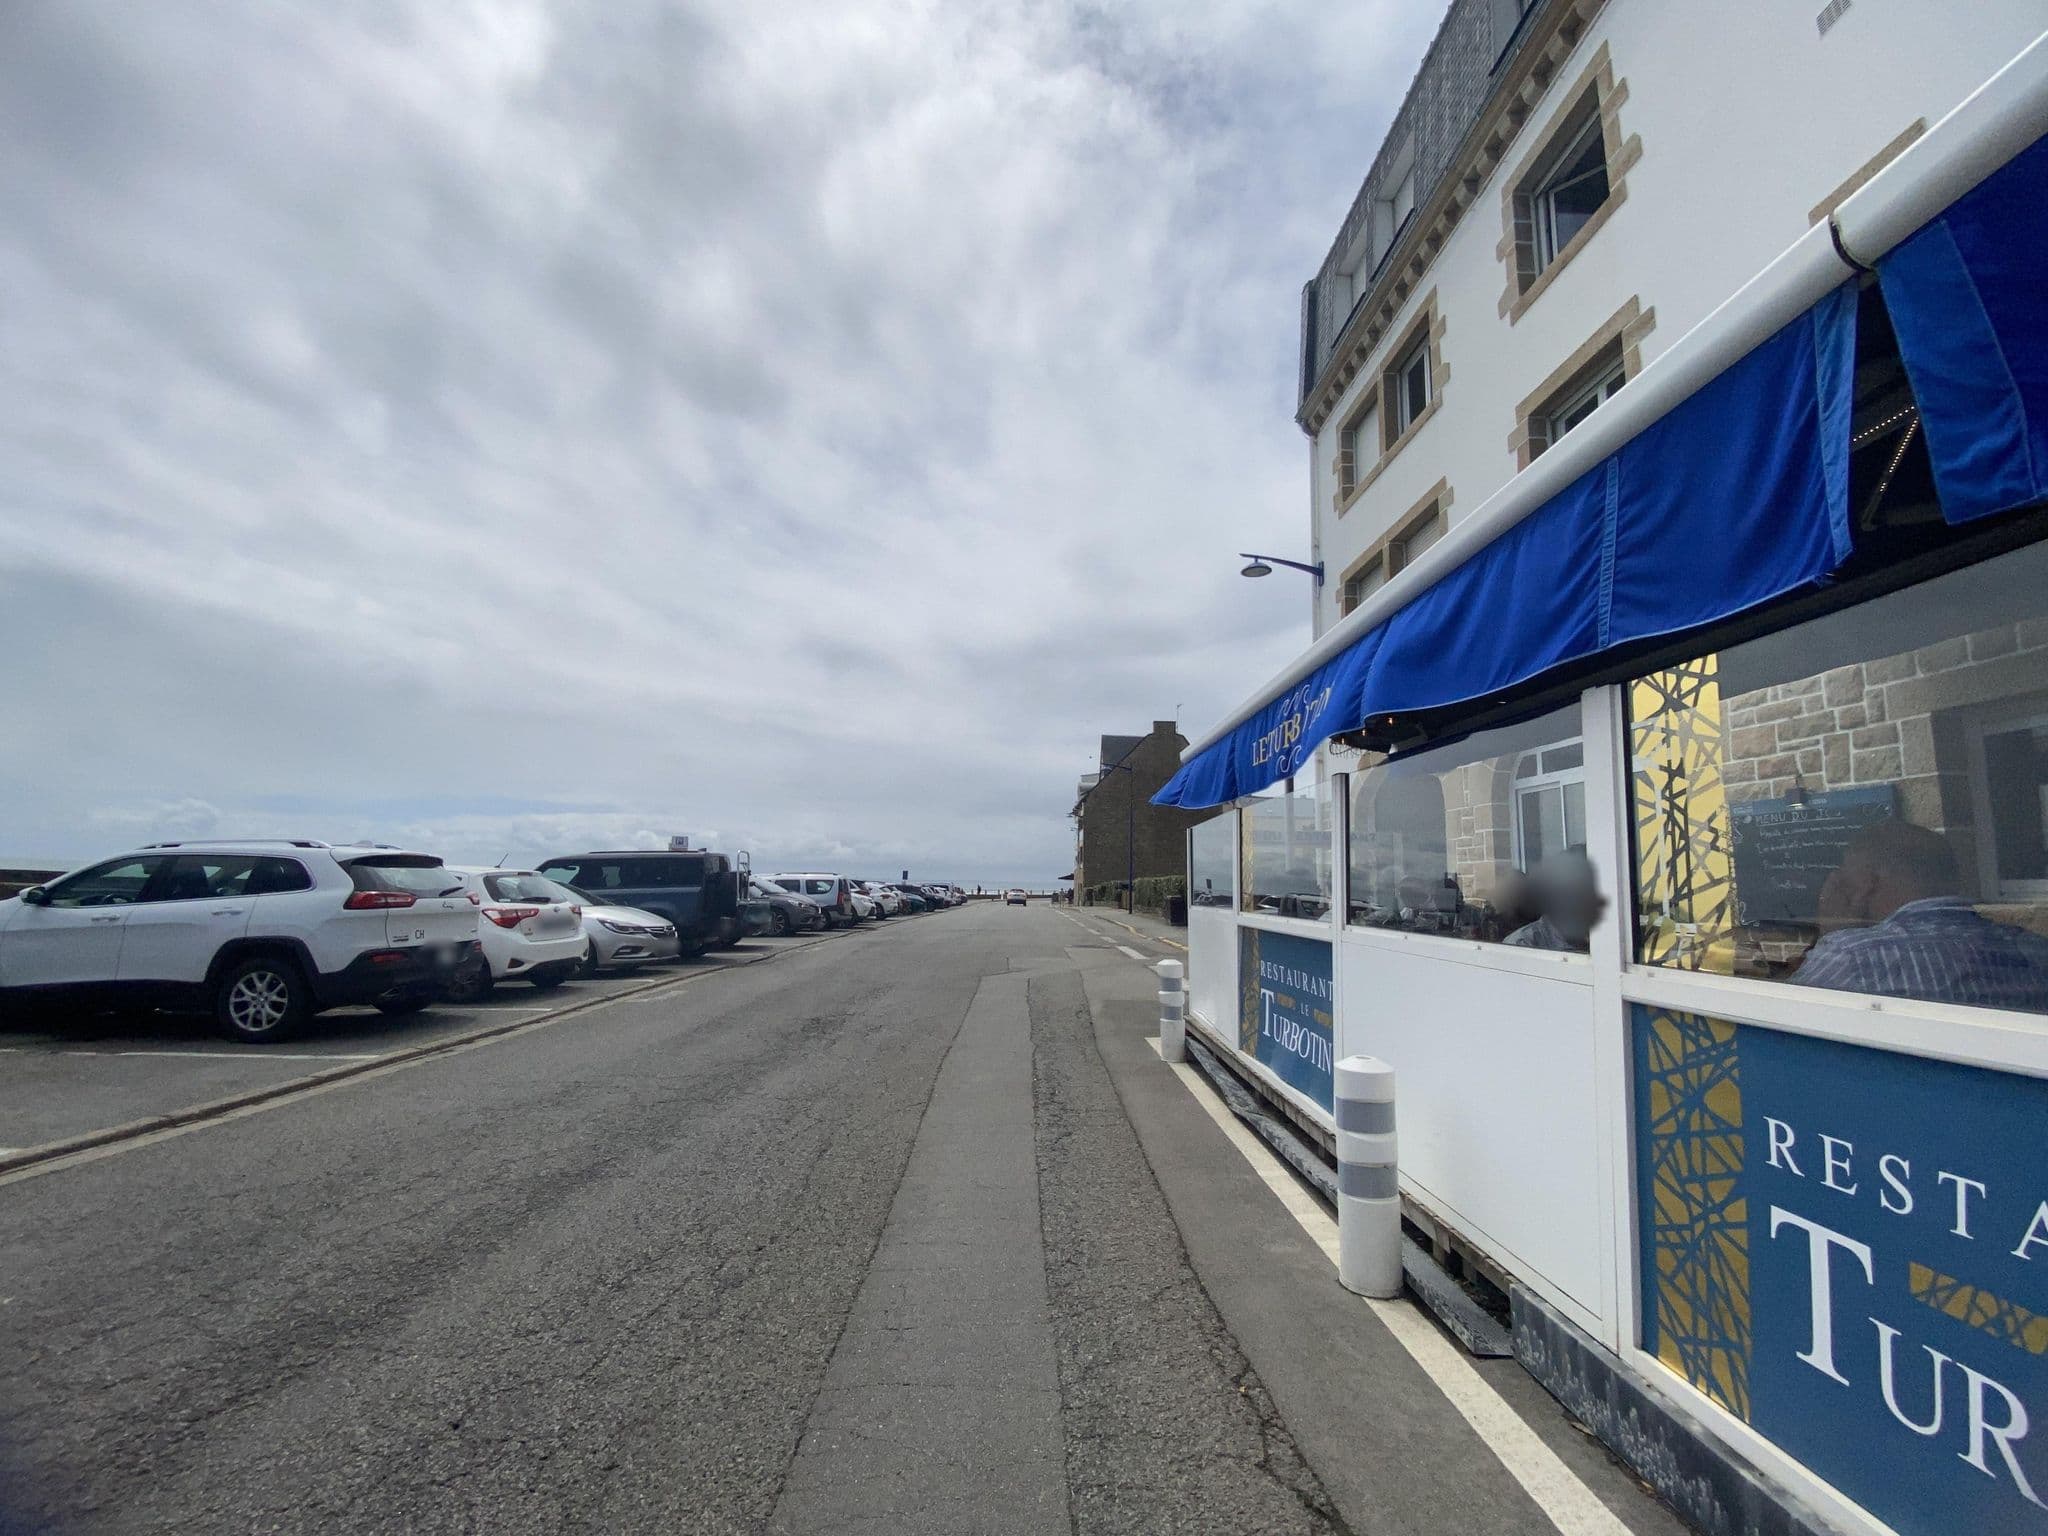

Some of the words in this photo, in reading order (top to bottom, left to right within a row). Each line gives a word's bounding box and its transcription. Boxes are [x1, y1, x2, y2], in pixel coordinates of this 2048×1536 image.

[1755, 812, 1786, 825] MENU
[415, 929, 425, 939] CH
[1260, 960, 1333, 1001] RESTAURANT
[1300, 1003, 1309, 1016] LE
[1261, 988, 1332, 1075] TURBOTIN
[1770, 1205, 2048, 1511] TUR
